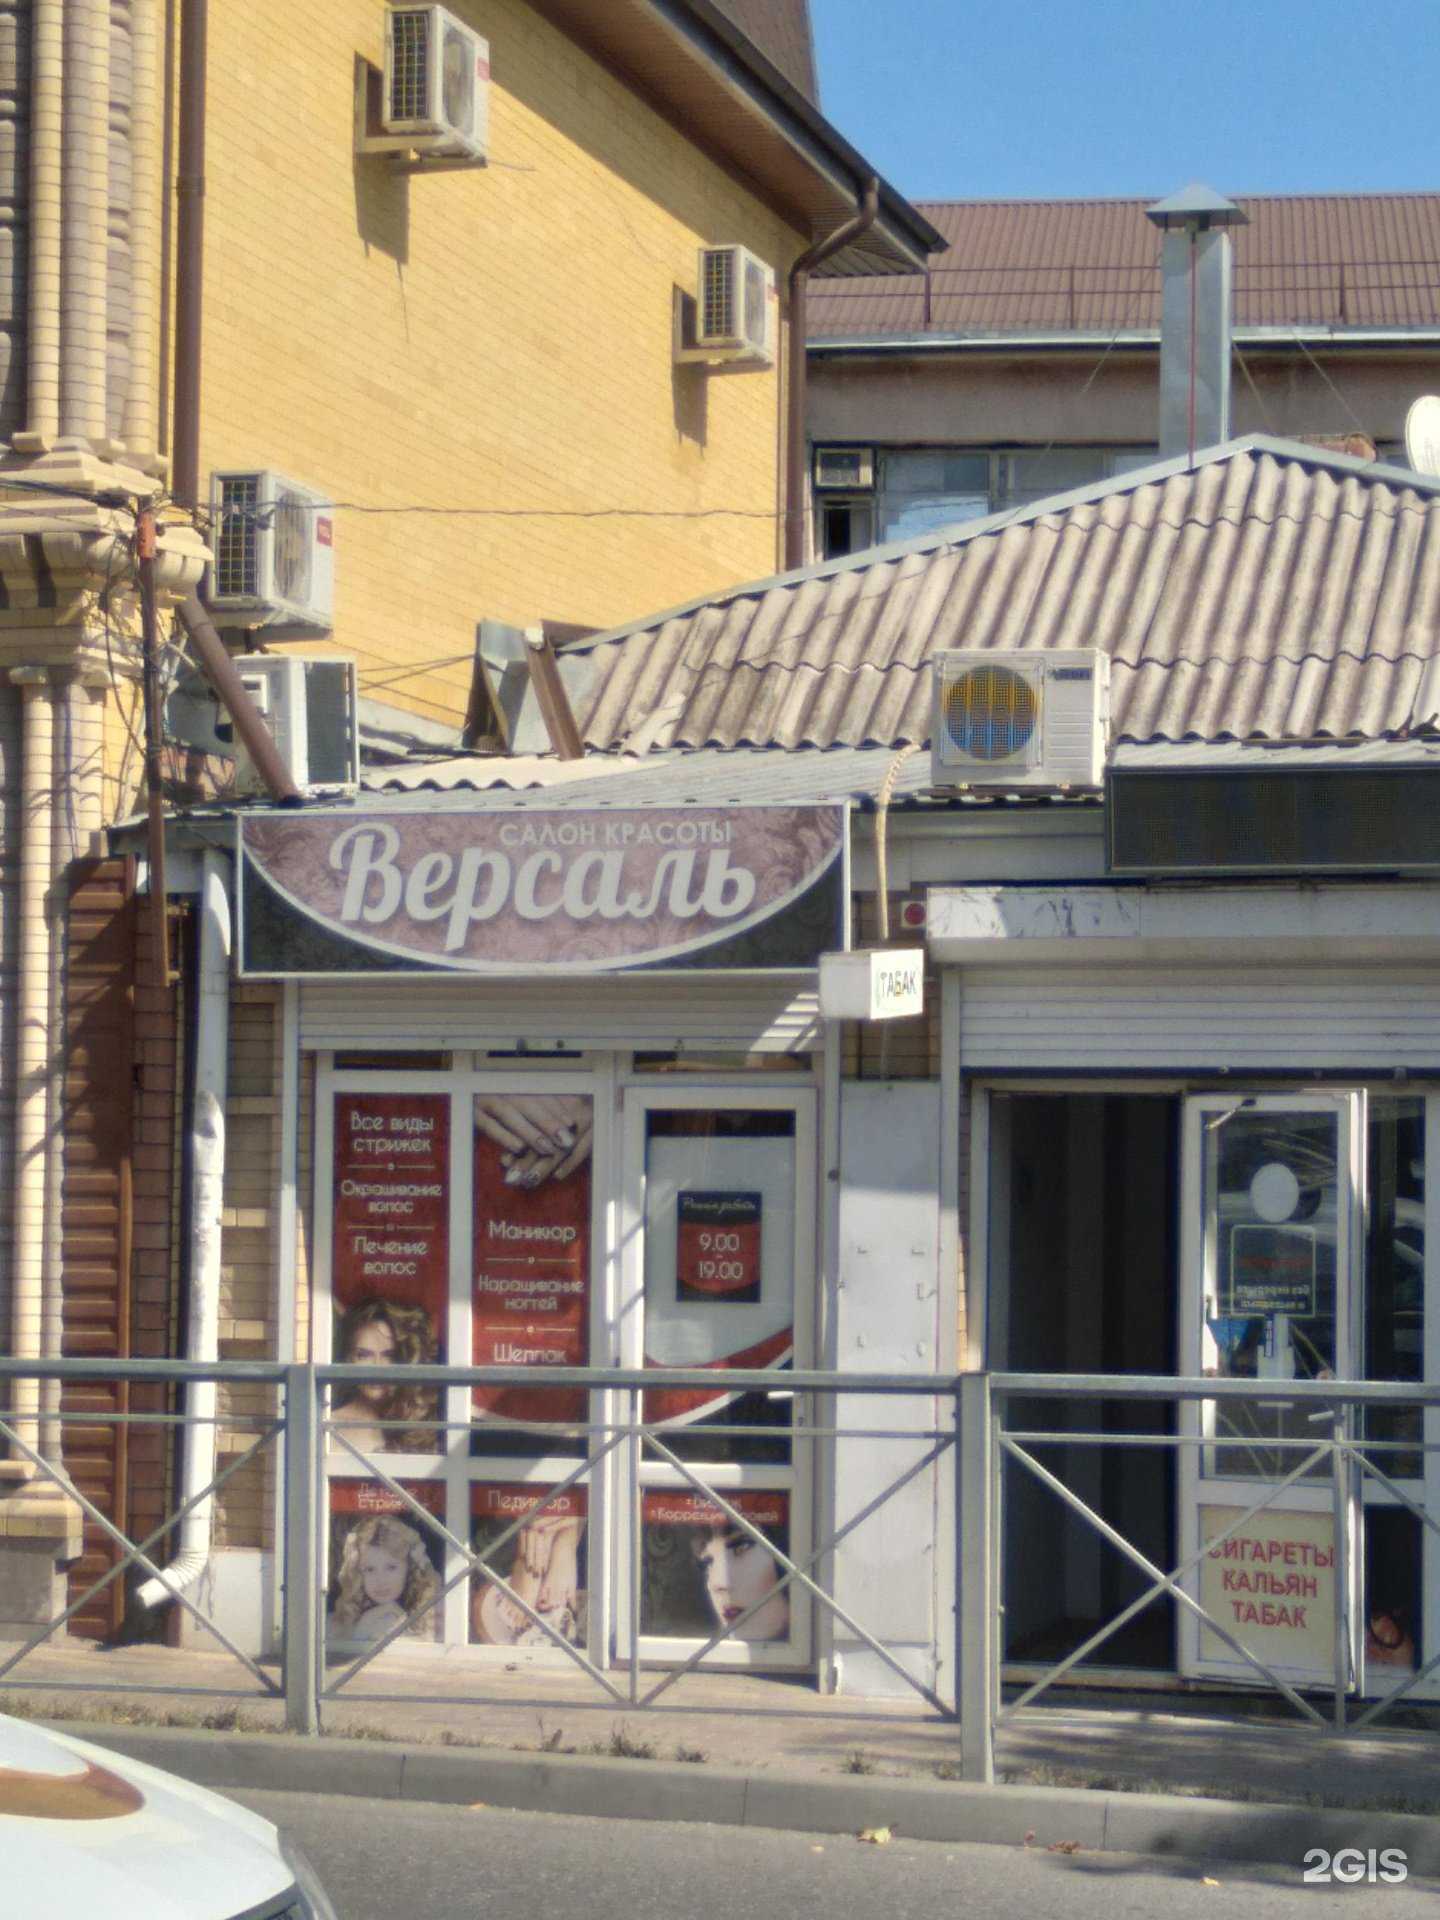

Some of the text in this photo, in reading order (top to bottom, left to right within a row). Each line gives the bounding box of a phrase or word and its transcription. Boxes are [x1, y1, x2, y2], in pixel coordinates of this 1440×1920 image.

[500, 820, 732, 846] САЛОН КРАСОТЫ
[329, 822, 756, 951] Версаль
[880, 970, 917, 998] ТАБАК
[351, 1110, 434, 1133] Все виды
[353, 1138, 431, 1154] стрижек
[341, 1179, 442, 1198] Окрашивание
[368, 1201, 413, 1214] волос
[488, 1219, 576, 1244] Маникюр
[699, 1233, 740, 1251] 9.00
[363, 1262, 416, 1275] волос
[699, 1260, 744, 1279] 19.00
[479, 1274, 584, 1295] Наращивание
[504, 1297, 557, 1311] ногтей
[494, 1343, 568, 1363] Шеллак
[487, 1489, 570, 1513] Педиюр
[1222, 1568, 1317, 1598] КАЛЬЯН
[1232, 1600, 1307, 1628] ТАБАК
